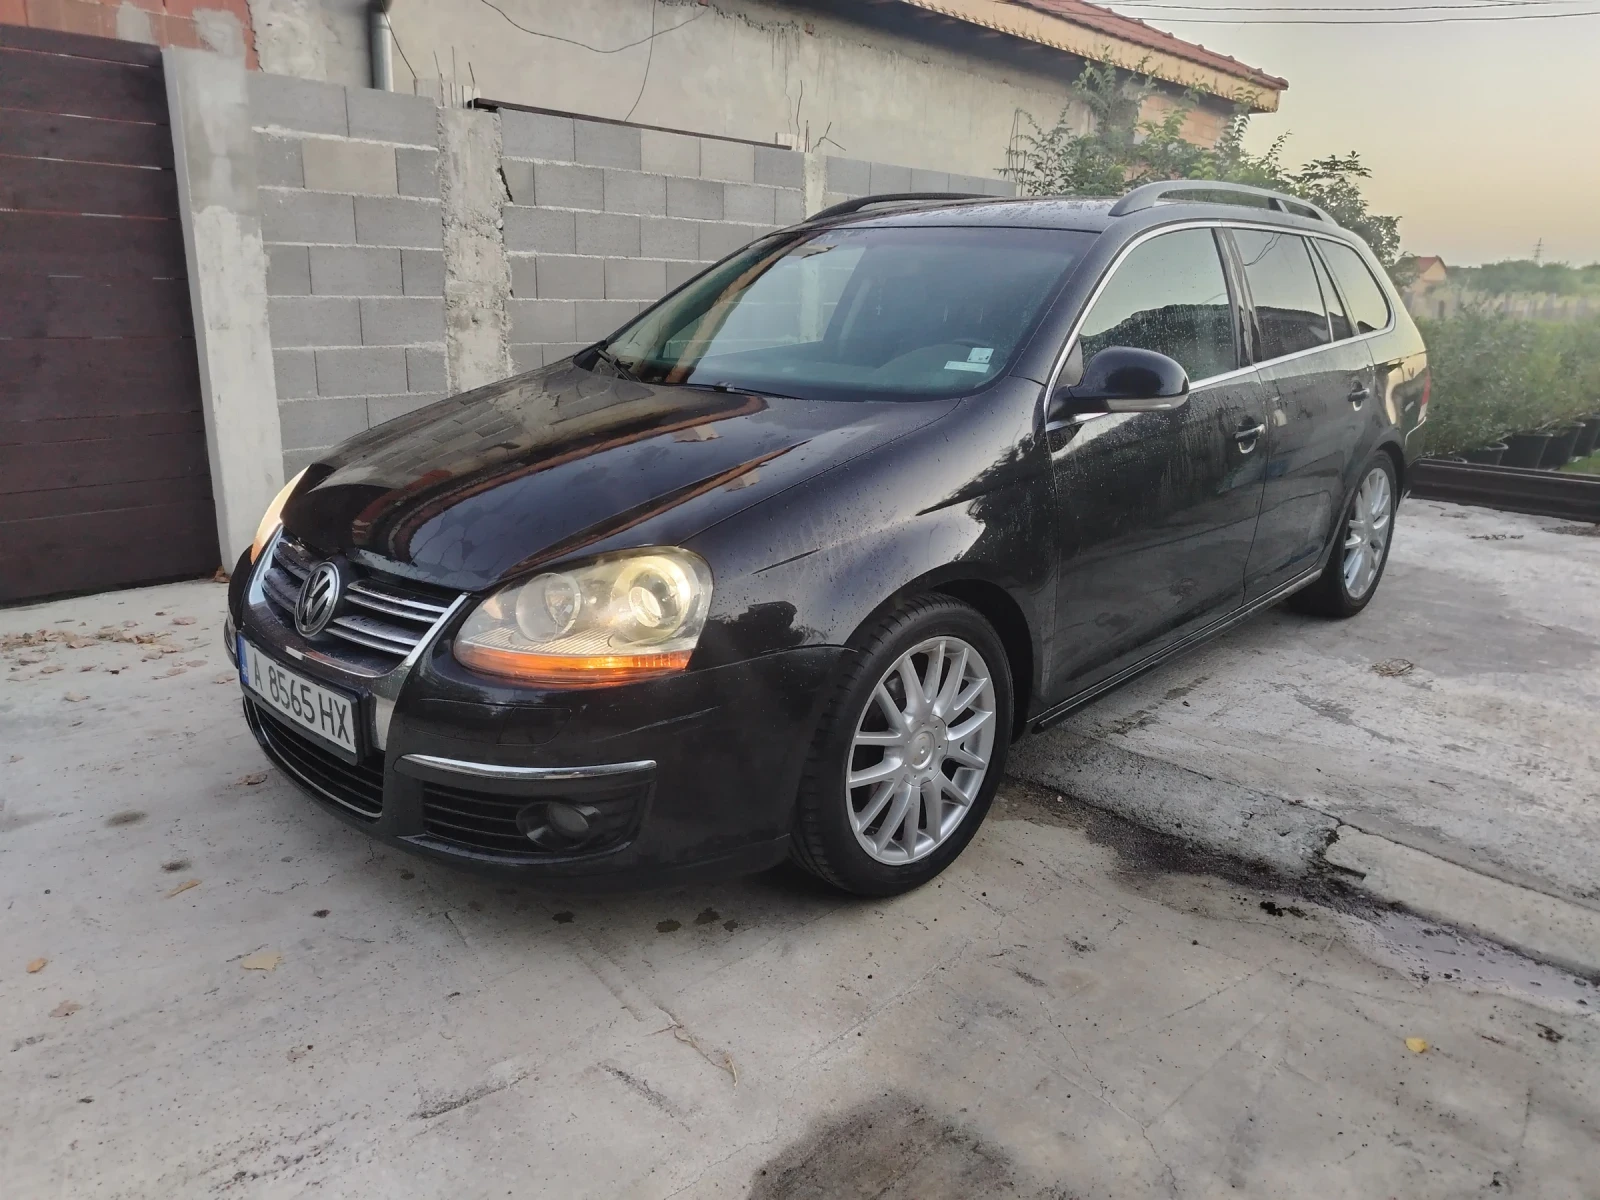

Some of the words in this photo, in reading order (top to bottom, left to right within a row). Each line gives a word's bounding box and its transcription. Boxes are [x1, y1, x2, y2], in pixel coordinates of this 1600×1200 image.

[254, 652, 264, 691] A
[268, 665, 315, 724] 8565
[318, 691, 350, 744] HX
